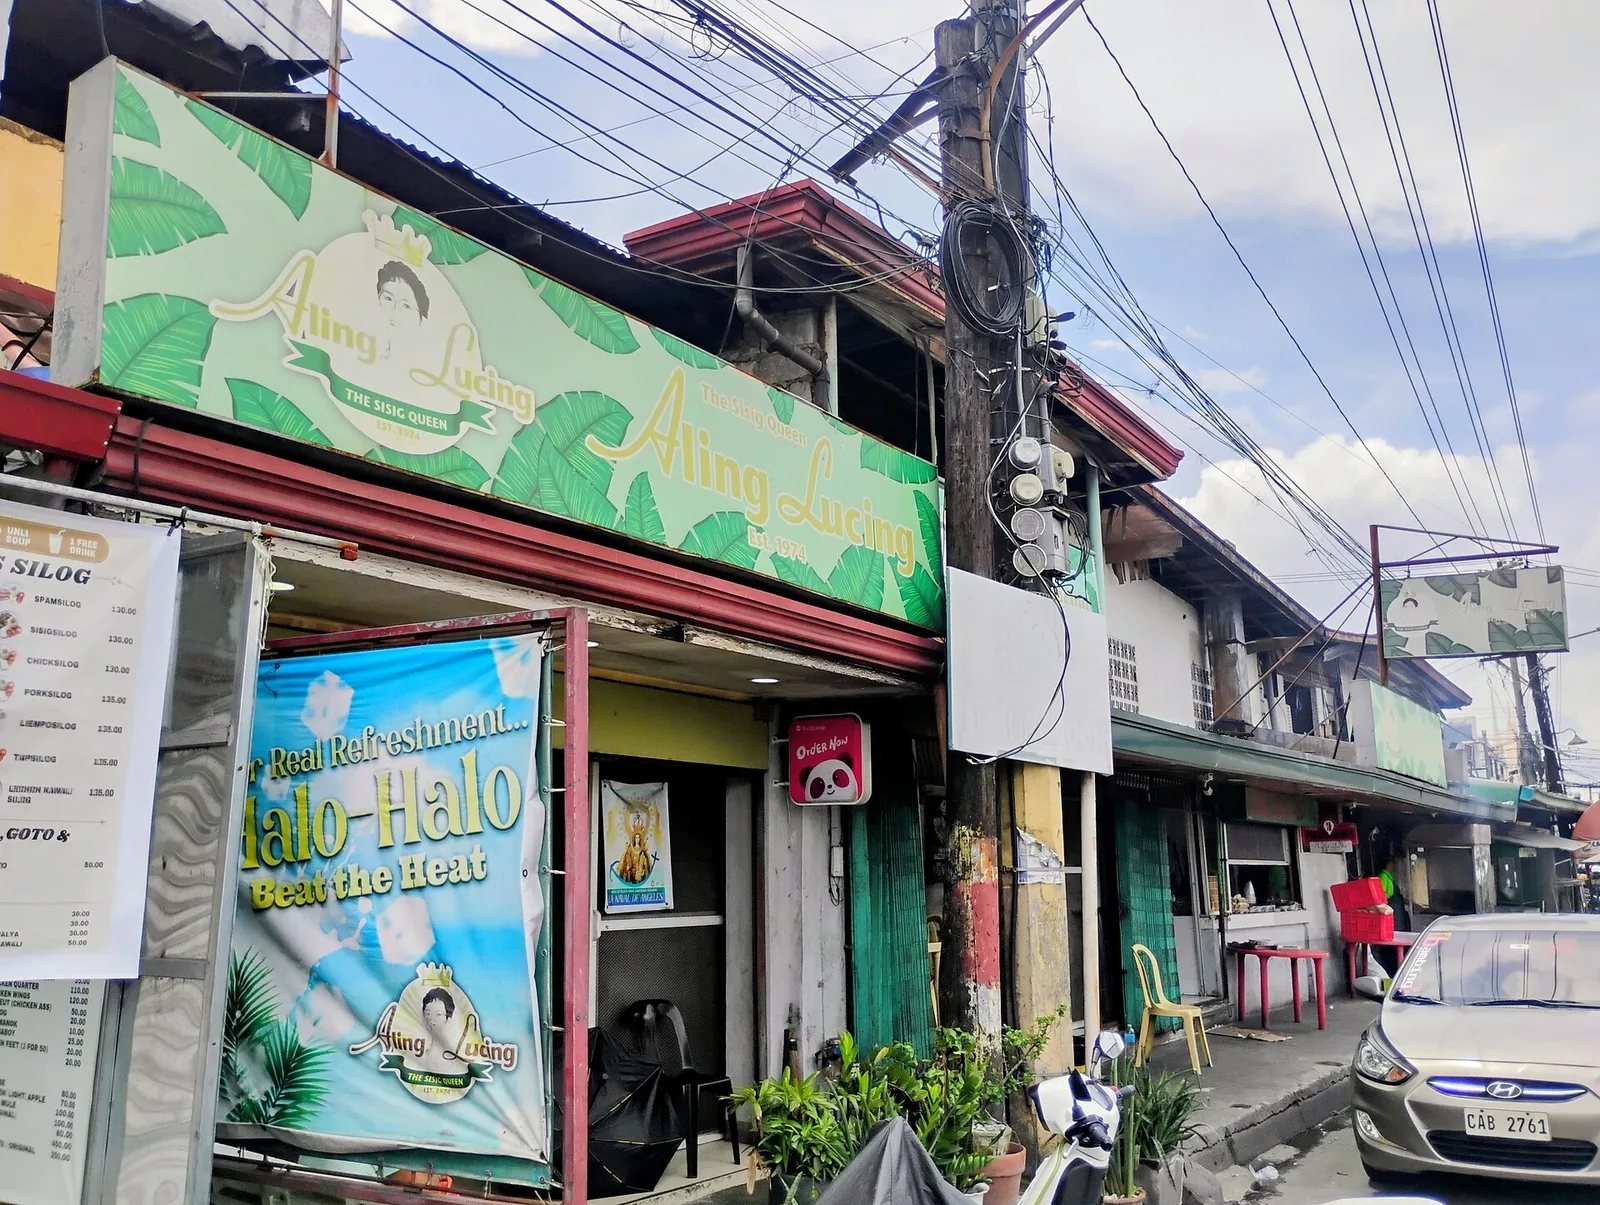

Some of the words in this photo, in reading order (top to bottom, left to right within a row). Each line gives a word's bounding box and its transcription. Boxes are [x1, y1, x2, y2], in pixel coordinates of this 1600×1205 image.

[214, 255, 378, 365] Aling
[410, 322, 532, 418] Lucing
[345, 388, 371, 409] THE
[374, 400, 405, 419] SISIG
[408, 411, 448, 431] QUEEN
[701, 383, 729, 410] The
[731, 397, 764, 431] Sisig
[766, 415, 806, 446] Queen
[585, 367, 770, 525] Aling
[777, 438, 915, 578] Lucing
[7, 526, 29, 537] UNLI
[70, 538, 75, 546] 1
[77, 539, 98, 549] FREE
[748, 526, 774, 552] Est.
[776, 537, 807, 563] 1974
[6, 536, 31, 547] SOUP
[69, 546, 96, 558] DRINK
[10, 558, 92, 585] SILOG
[34, 595, 82, 609] SPAMSILOG
[112, 606, 137, 616] 130.00
[30, 626, 78, 638] SISIGSILOG
[108, 635, 133, 645] 130.00
[27, 657, 79, 669] CHICKSILOG
[105, 665, 130, 675] 130.00
[24, 688, 72, 700] PORKSILOG
[101, 695, 126, 705] 135.00
[20, 719, 77, 731] LIEMPOSILOG
[270, 738, 323, 781] Real
[330, 702, 529, 768] Refreshment...
[7, 795, 31, 804] SILOG
[88, 788, 115, 798] 135.00
[83, 861, 104, 869] 50.00
[250, 864, 329, 912] Beat
[333, 859, 393, 899] the
[399, 843, 488, 890] Heat
[71, 910, 91, 918] 30.00
[67, 939, 88, 947] 50.00
[12, 990, 31, 1000] WINGS
[70, 986, 90, 995] 110.00
[13, 981, 40, 991] QUARTER
[11, 1000, 38, 1009] (CHICKEN
[38, 1003, 52, 1012] ASS)
[69, 997, 89, 1005] 120.00
[71, 1008, 87, 1016] 50.00
[70, 1017, 87, 1025] 20.00
[69, 1028, 85, 1036] 10.00
[351, 1004, 426, 1058] Aling
[443, 1013, 516, 1068] Lucing
[6, 1040, 19, 1048] FEET
[27, 1043, 38, 1051] FOR
[68, 1038, 83, 1046] 25.00
[66, 1048, 82, 1056] 20.00
[65, 1058, 81, 1067] 20.00
[407, 1072, 423, 1083] THE
[442, 1077, 464, 1086] QUEEN
[60, 1099, 76, 1109] 70.00
[1467, 1113, 1496, 1131] CAB
[1507, 1116, 1548, 1135] 2761
